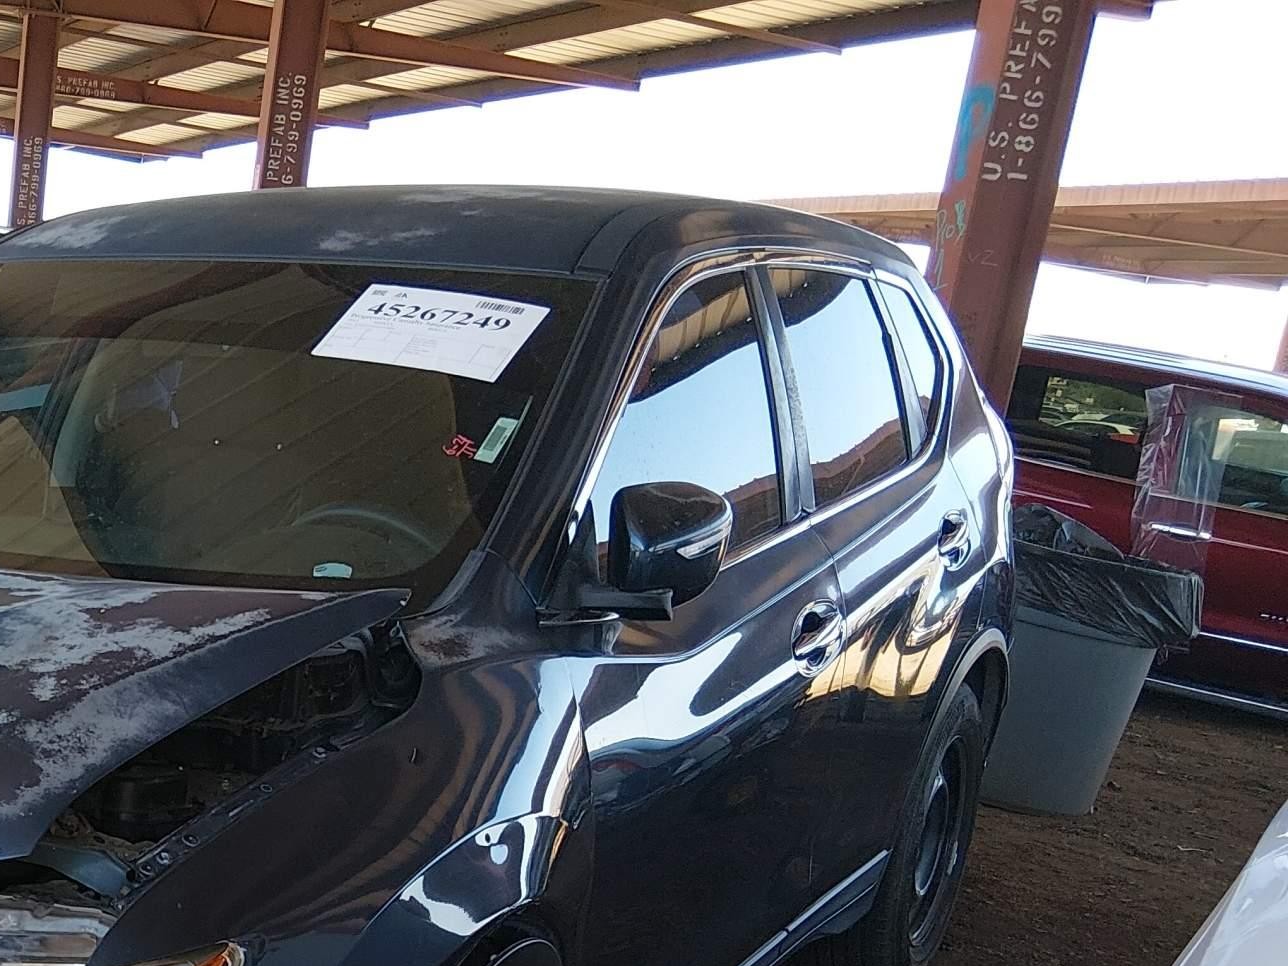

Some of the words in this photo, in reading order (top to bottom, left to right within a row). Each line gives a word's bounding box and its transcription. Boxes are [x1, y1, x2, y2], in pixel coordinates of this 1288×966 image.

[276, 72, 292, 105] INC.
[266, 114, 287, 181] PREFAB
[18, 163, 31, 209] PREFAB
[367, 301, 512, 331] 45267249
